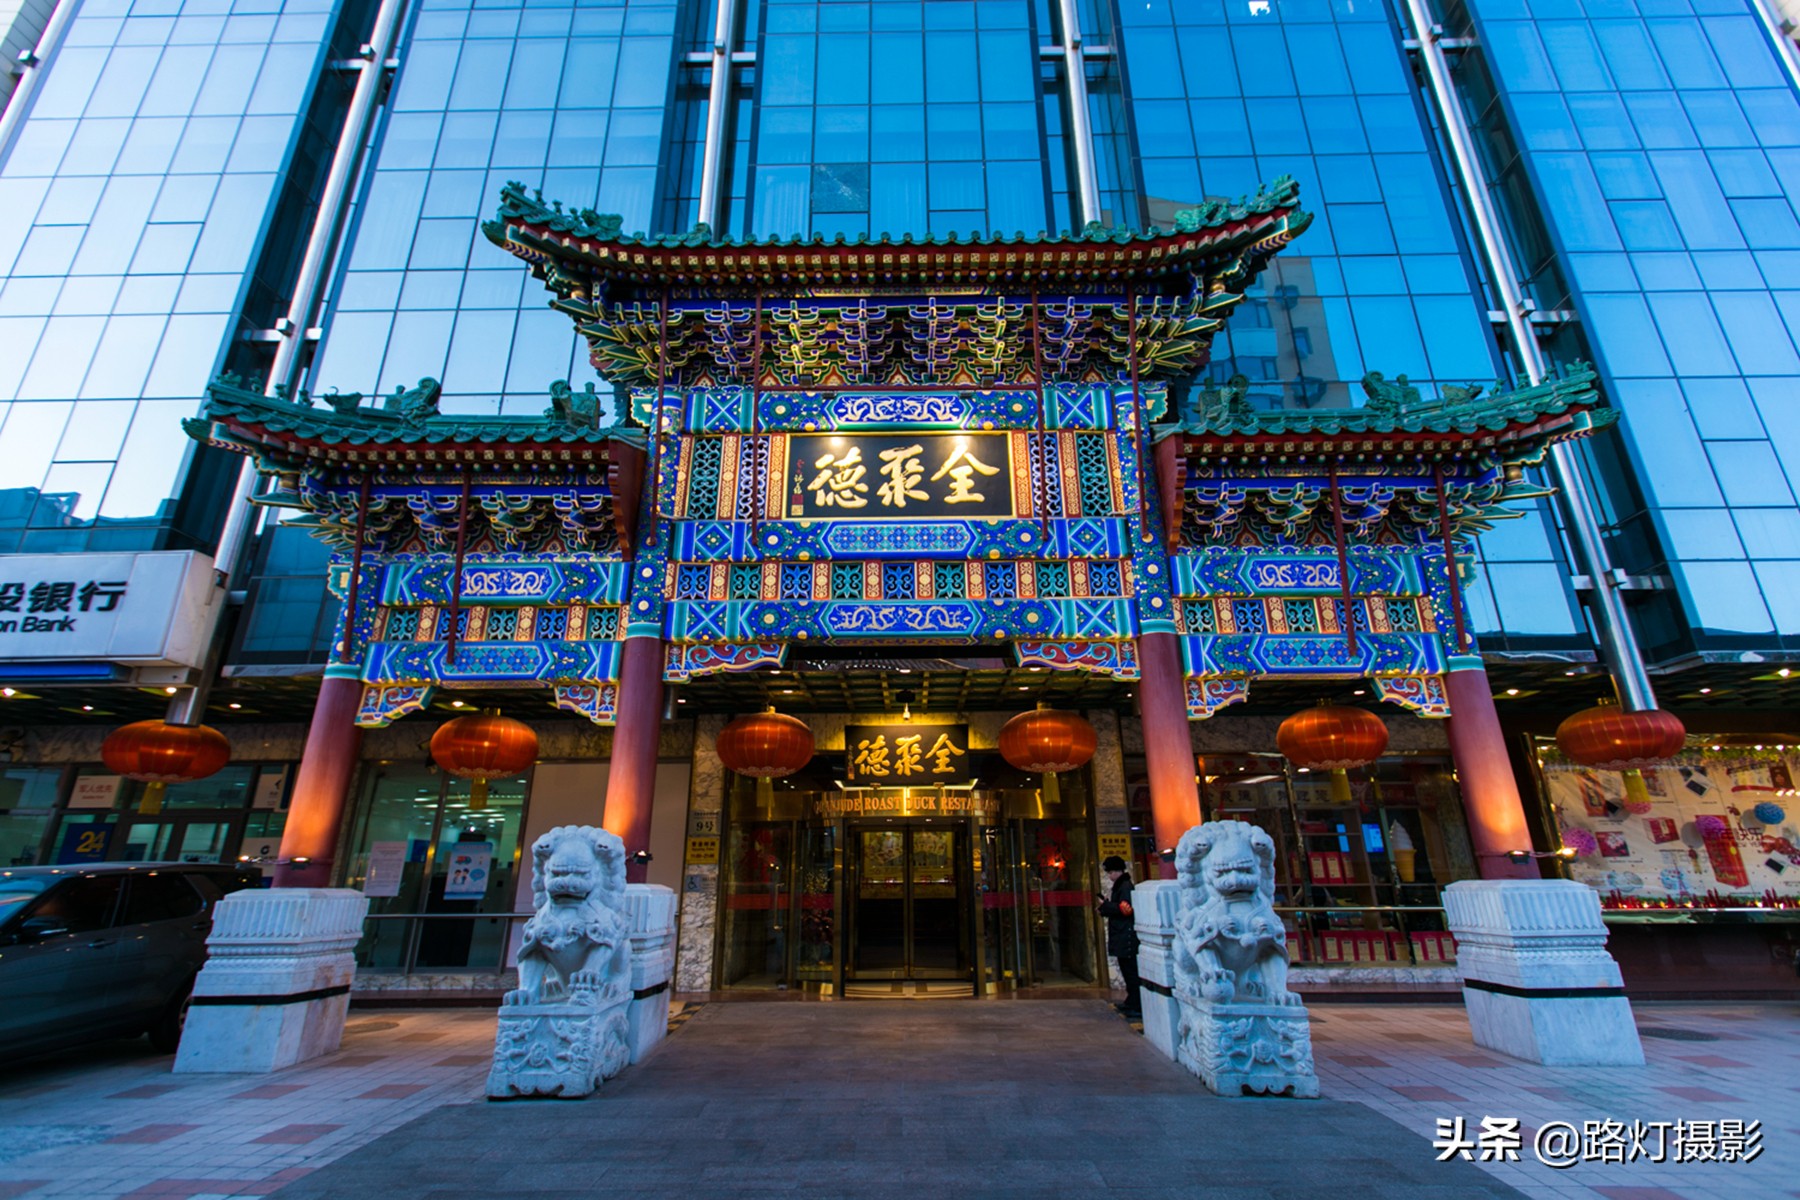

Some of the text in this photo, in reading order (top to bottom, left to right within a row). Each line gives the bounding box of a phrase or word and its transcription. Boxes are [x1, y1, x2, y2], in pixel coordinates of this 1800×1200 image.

[807, 442, 1001, 509] 全聚德
[20, 615, 76, 633] Bank
[854, 732, 966, 777] 全聚德
[864, 796, 901, 811] ROAST
[906, 796, 937, 811] DUCK
[76, 830, 107, 853] 24
